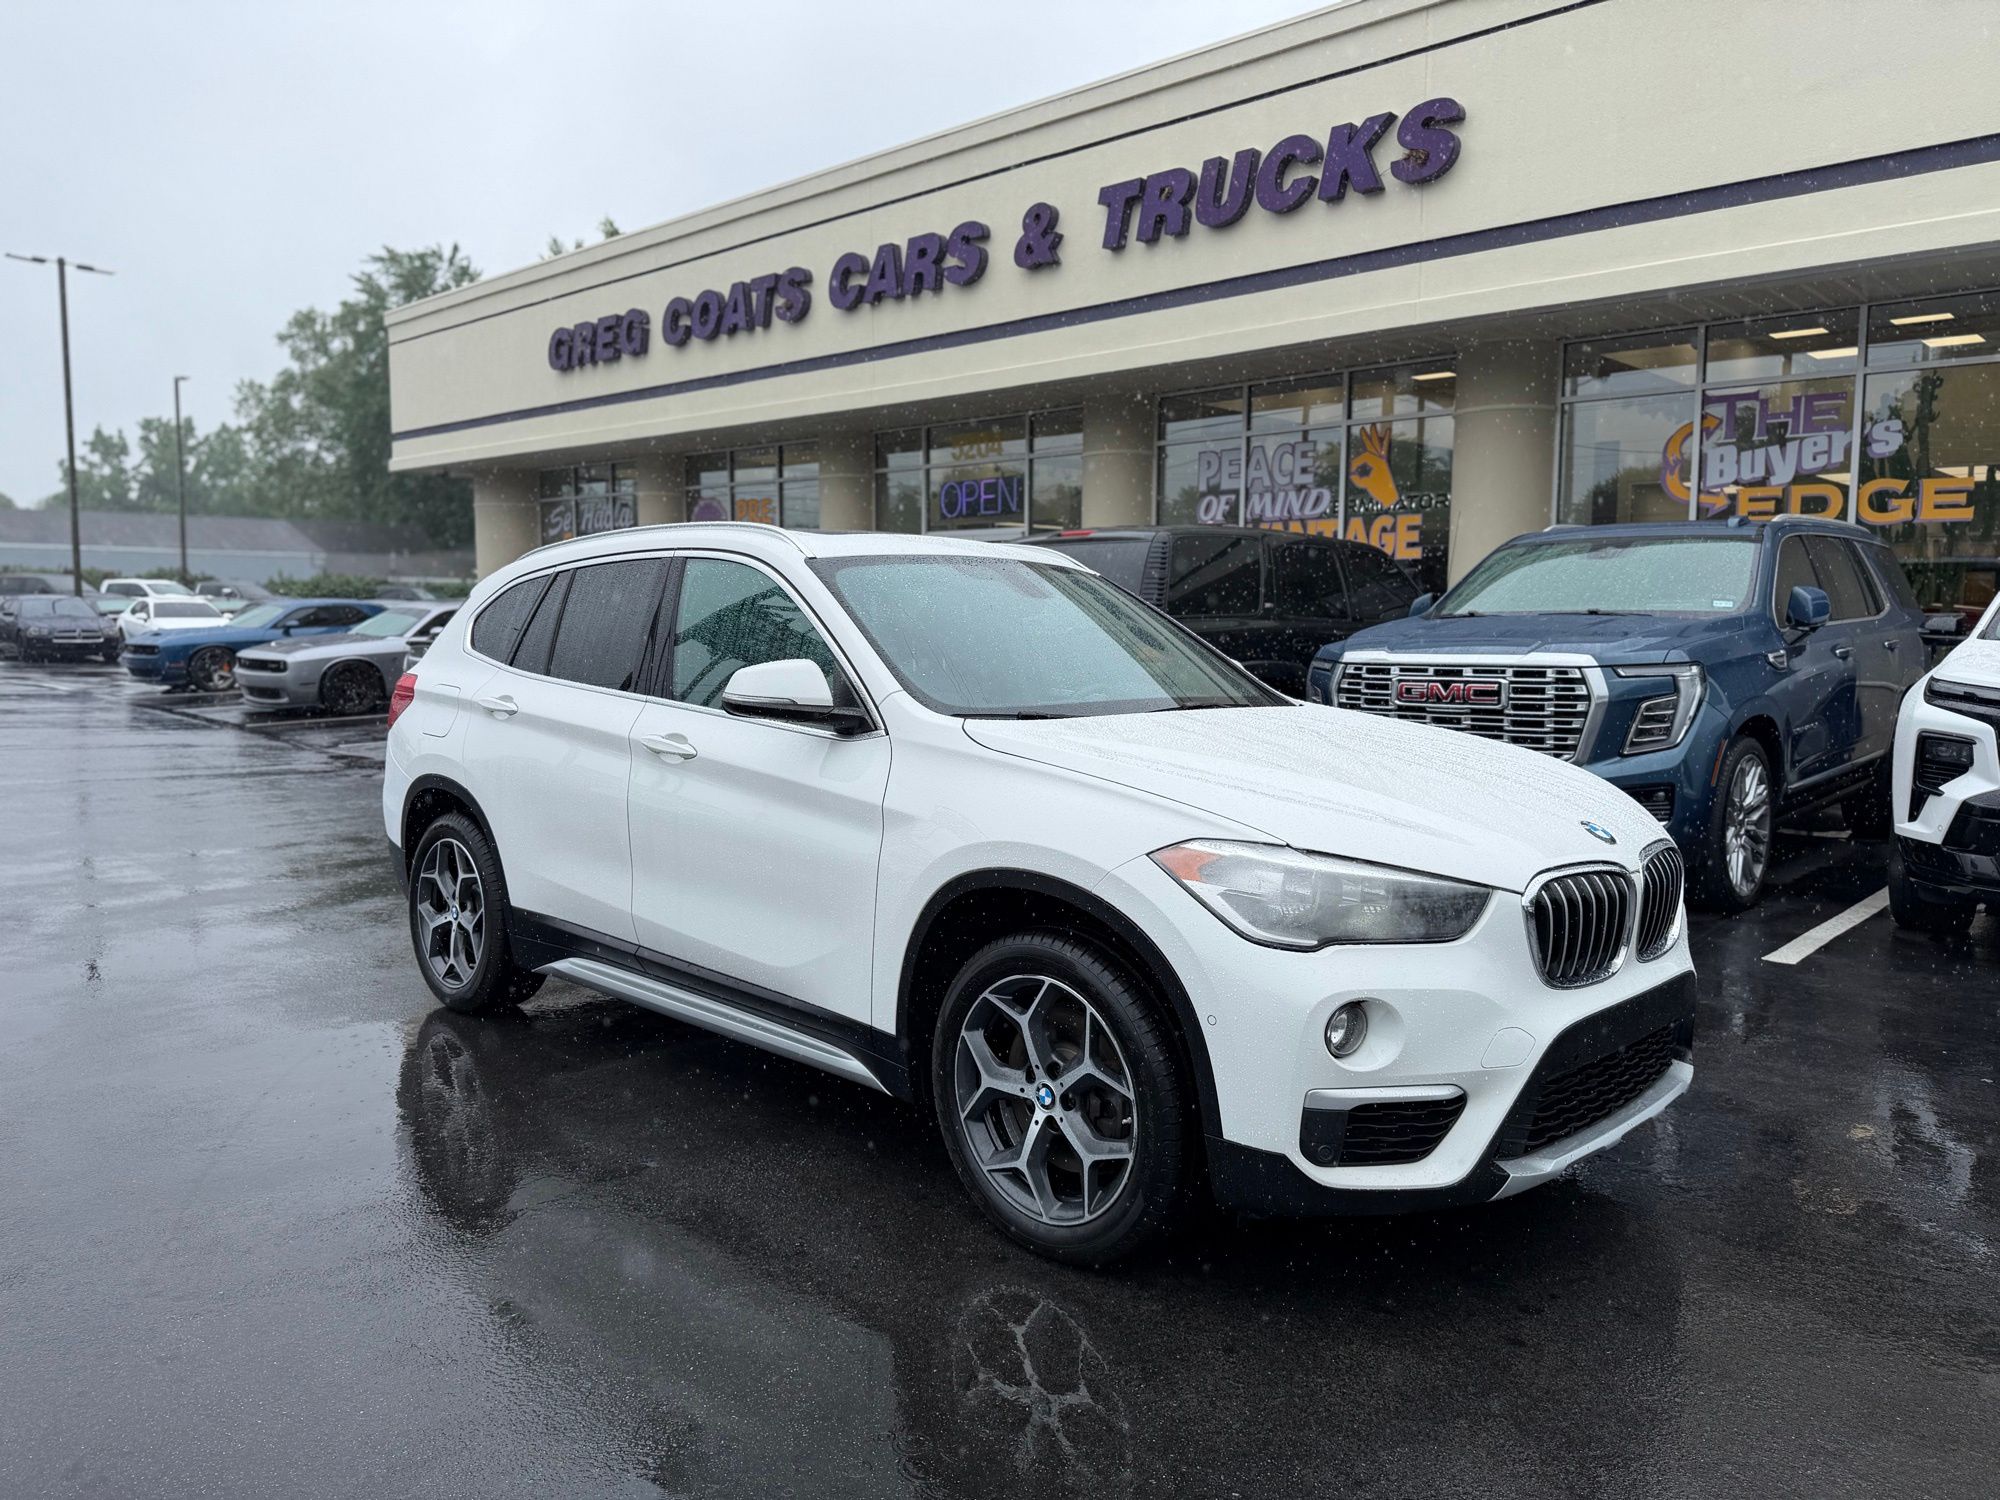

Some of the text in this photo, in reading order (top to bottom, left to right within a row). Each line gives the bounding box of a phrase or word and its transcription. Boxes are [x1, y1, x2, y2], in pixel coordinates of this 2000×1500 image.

[549, 97, 1466, 371] GREG COATS CARS & TRUCKS
[1704, 388, 1848, 442] THE
[1197, 440, 1316, 492] PEACE
[940, 478, 1019, 518] OPEN
[1197, 488, 1332, 524] OF MIND
[1736, 476, 1976, 525] EDGE
[1398, 682, 1499, 703] GMC
